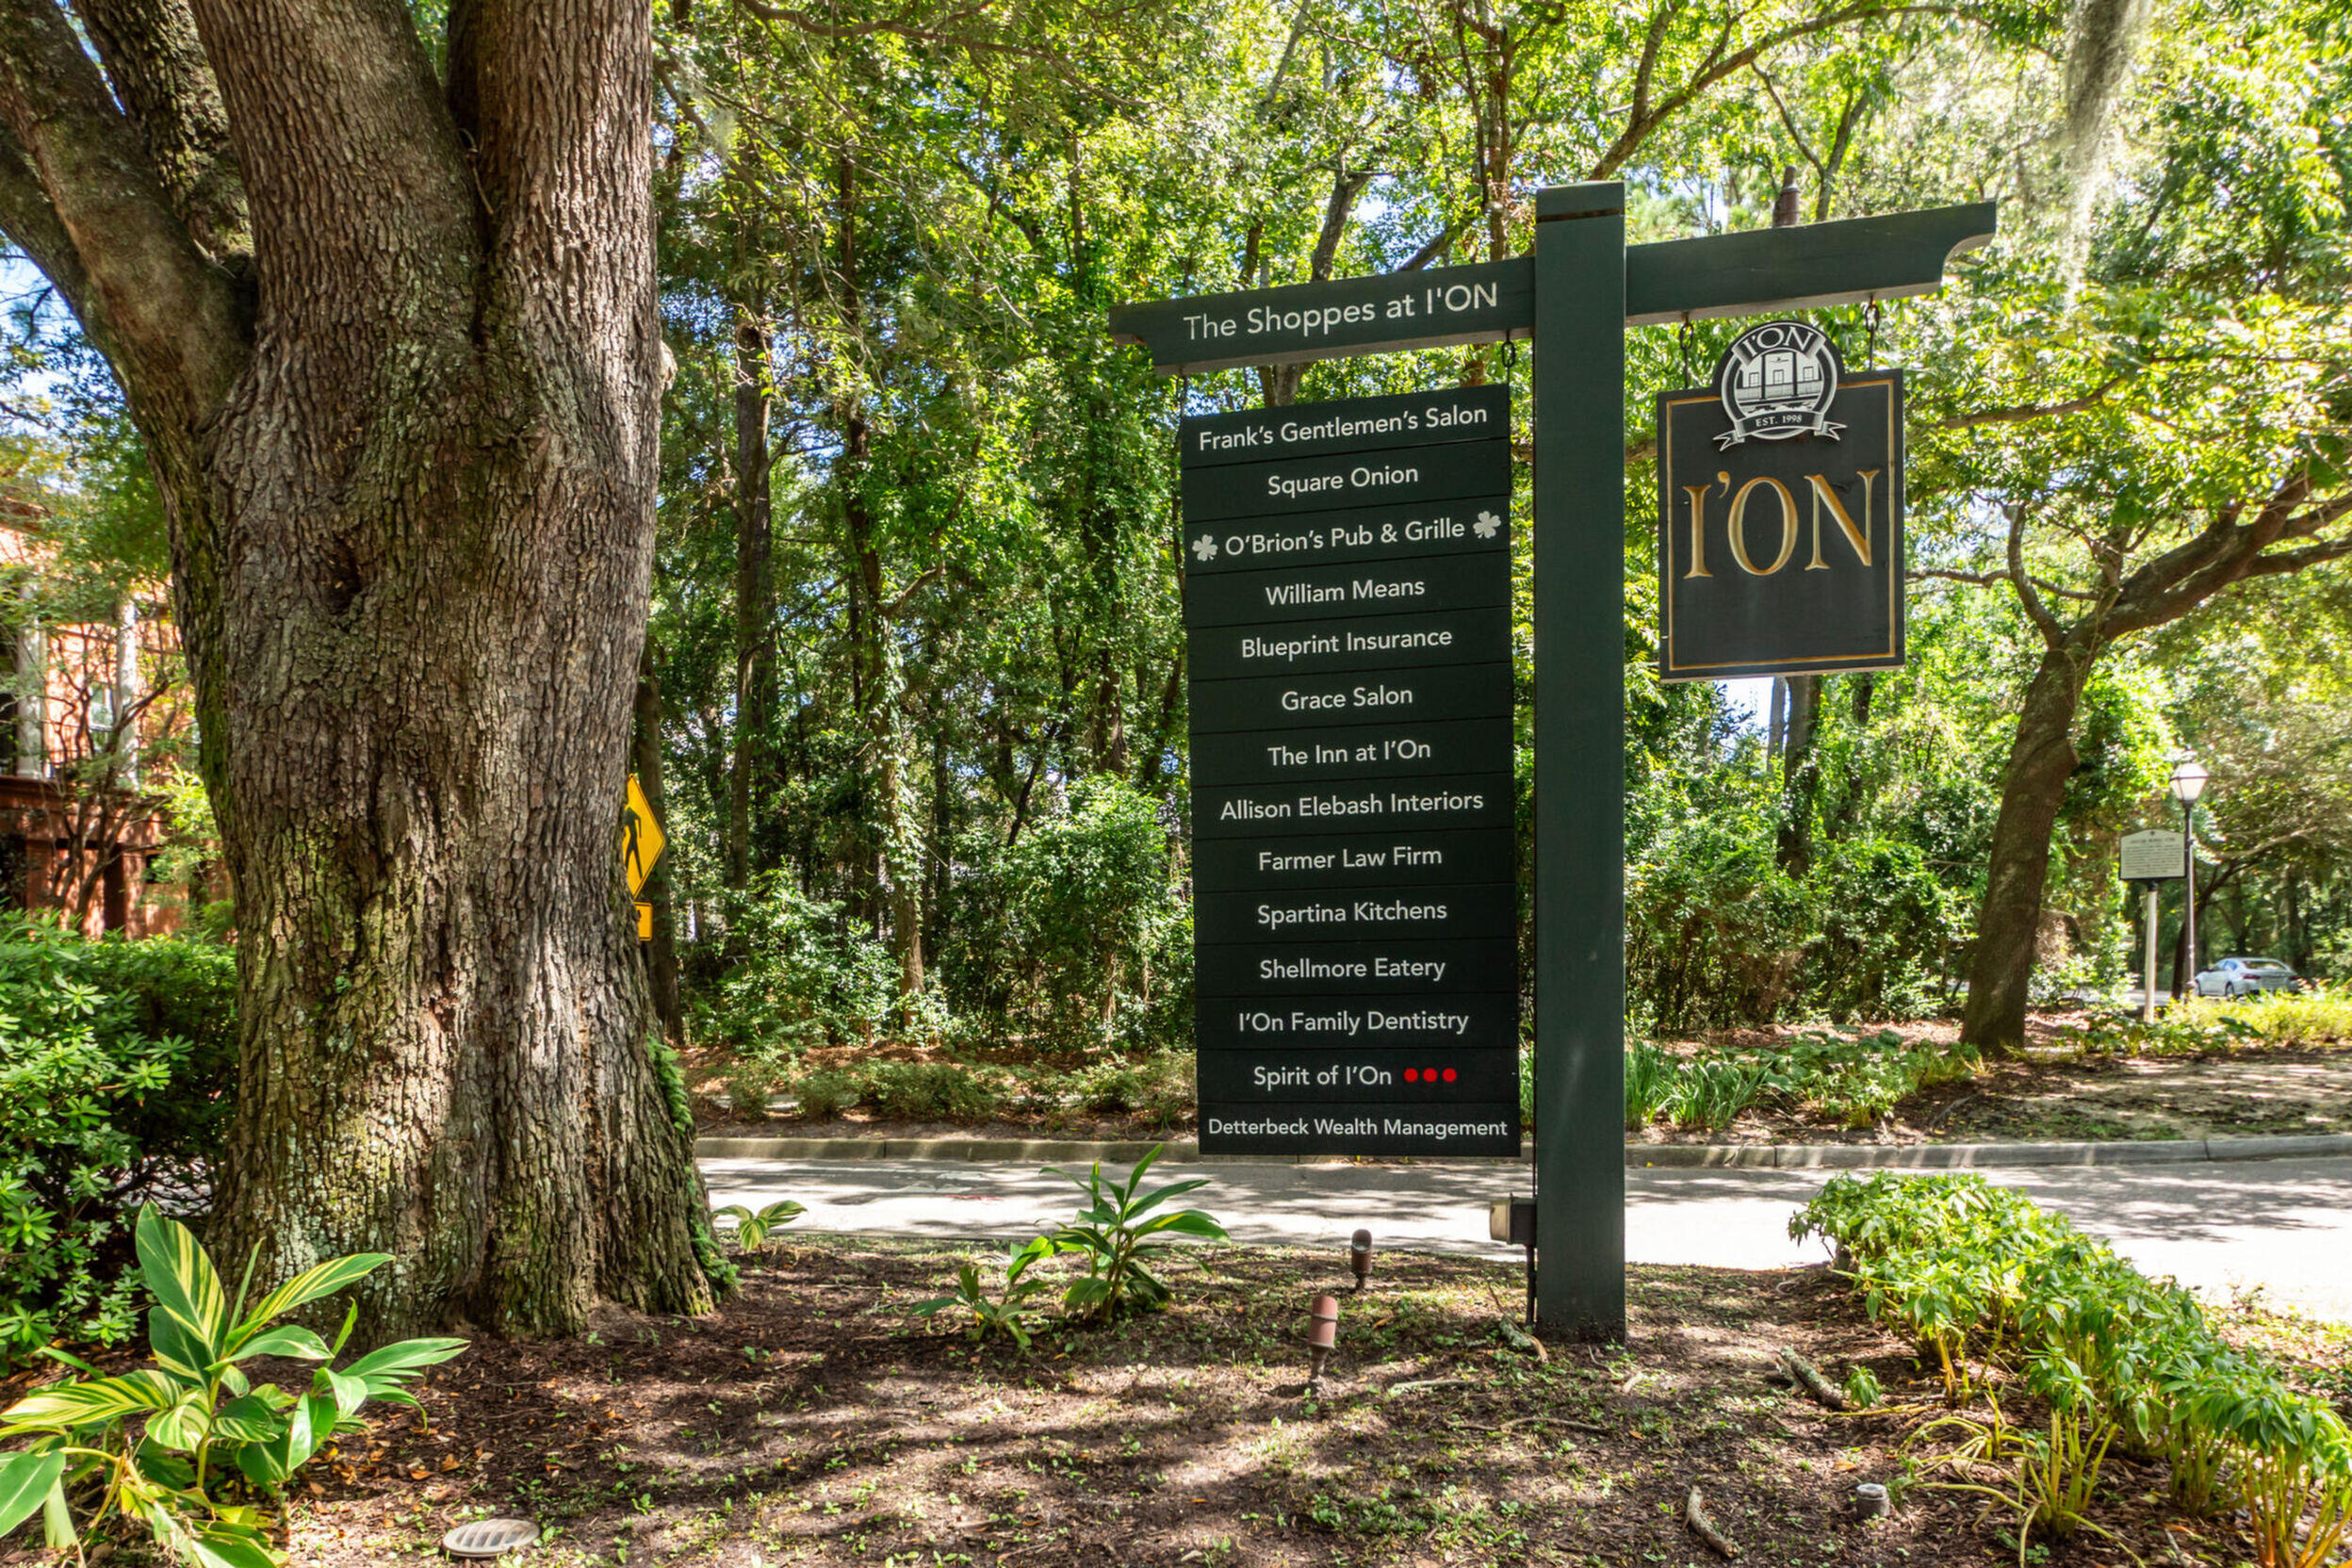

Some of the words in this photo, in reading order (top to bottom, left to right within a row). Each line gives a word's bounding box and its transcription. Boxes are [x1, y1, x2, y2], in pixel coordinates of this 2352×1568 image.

[1184, 313, 1236, 339] The
[1248, 303, 1375, 336] Shoppes
[1386, 295, 1415, 318] at
[1428, 283, 1496, 314] I'ON
[1742, 327, 1814, 357] I'ON
[1200, 426, 1273, 450] Frank's
[1281, 411, 1418, 442] Gentlemen's
[1426, 404, 1487, 428] Salon
[1756, 416, 1779, 426] EST.
[1782, 414, 1803, 424] 1998
[1268, 476, 1343, 498] Square
[1351, 466, 1418, 487] Onion
[1226, 531, 1323, 555] O'Brion's
[1331, 525, 1373, 547] Pub
[1380, 524, 1397, 543] &
[1405, 517, 1464, 541] Grille
[1682, 469, 1881, 580] I'ON
[1266, 583, 1344, 605] William
[1353, 580, 1425, 599] Means
[1242, 635, 1339, 662] Blueprint
[1348, 631, 1452, 651] Insurance
[1282, 691, 1346, 710] Grace
[1353, 685, 1413, 706] Salon
[1267, 746, 1308, 765] The
[1316, 745, 1348, 763] Inn
[1356, 744, 1376, 761] at
[1385, 740, 1430, 760] I'On
[1220, 799, 1290, 820] Allison
[1299, 793, 1382, 816] Elebash
[1392, 792, 1483, 812] Interiors
[1260, 852, 1335, 871] Farmer
[1344, 849, 1385, 867] Law
[1394, 846, 1442, 865] Firm
[1258, 904, 1346, 930] Spartina
[1355, 900, 1446, 921] Kitchens
[1261, 958, 1366, 978] Shellmore
[1376, 958, 1446, 981] Eatery
[1240, 1013, 1282, 1031] I'On
[1292, 1011, 1360, 1036] Family
[1368, 1011, 1468, 1034] Dentistry
[1254, 1067, 1310, 1091] Spirit
[1317, 1065, 1338, 1085] of
[1347, 1066, 1391, 1085] I'On
[1209, 1118, 1309, 1135] Detterbeck
[1315, 1119, 1377, 1135] Wealth
[1384, 1119, 1508, 1139] Management
